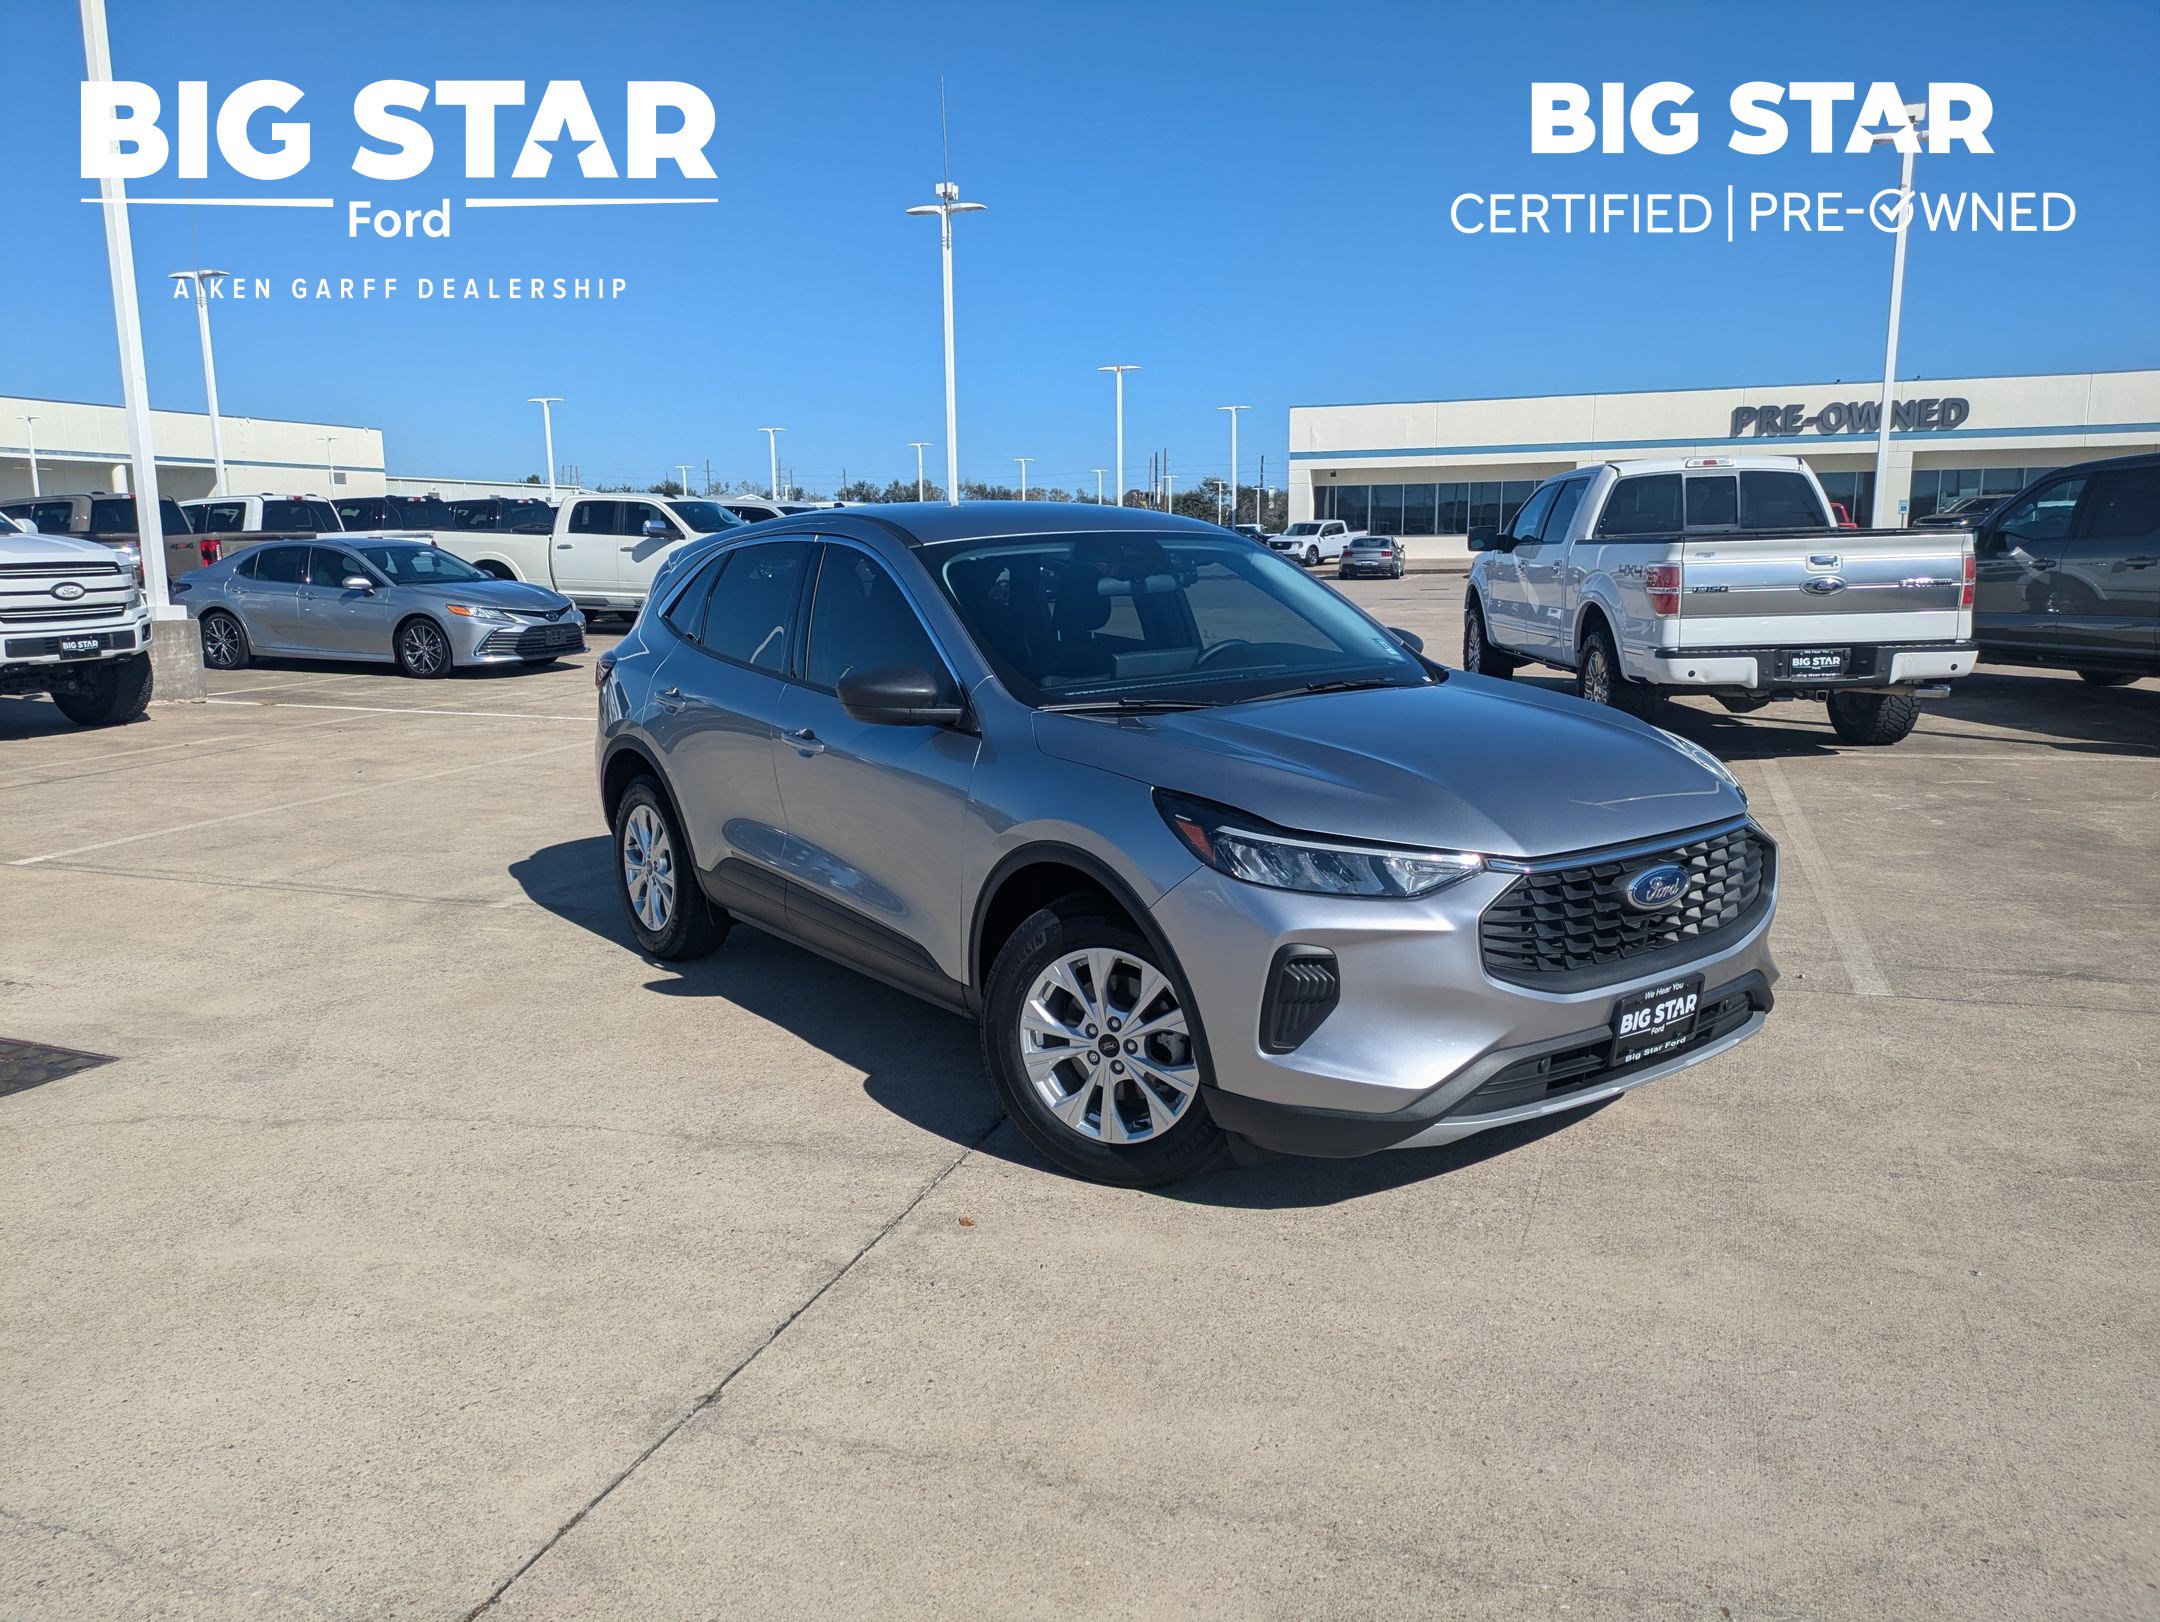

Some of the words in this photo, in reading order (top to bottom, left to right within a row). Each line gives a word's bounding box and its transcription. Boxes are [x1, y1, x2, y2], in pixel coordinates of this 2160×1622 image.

[1730, 397, 1970, 438] PRE-OWNED
[62, 641, 77, 650] BIG
[77, 639, 99, 649] STAR
[1792, 657, 1811, 667] BIG
[1812, 656, 1841, 666] STAR
[1645, 876, 1680, 901] Ford
[1644, 991, 1655, 1000] We
[1656, 986, 1671, 996] Hear
[1672, 982, 1685, 991] You
[1619, 1007, 1651, 1035] BIG
[1653, 993, 1698, 1024] STAR
[1650, 1023, 1665, 1035] Ford
[1625, 1052, 1641, 1063] Big
[1643, 1044, 1662, 1056] Star
[1665, 1036, 1687, 1049] Ford
